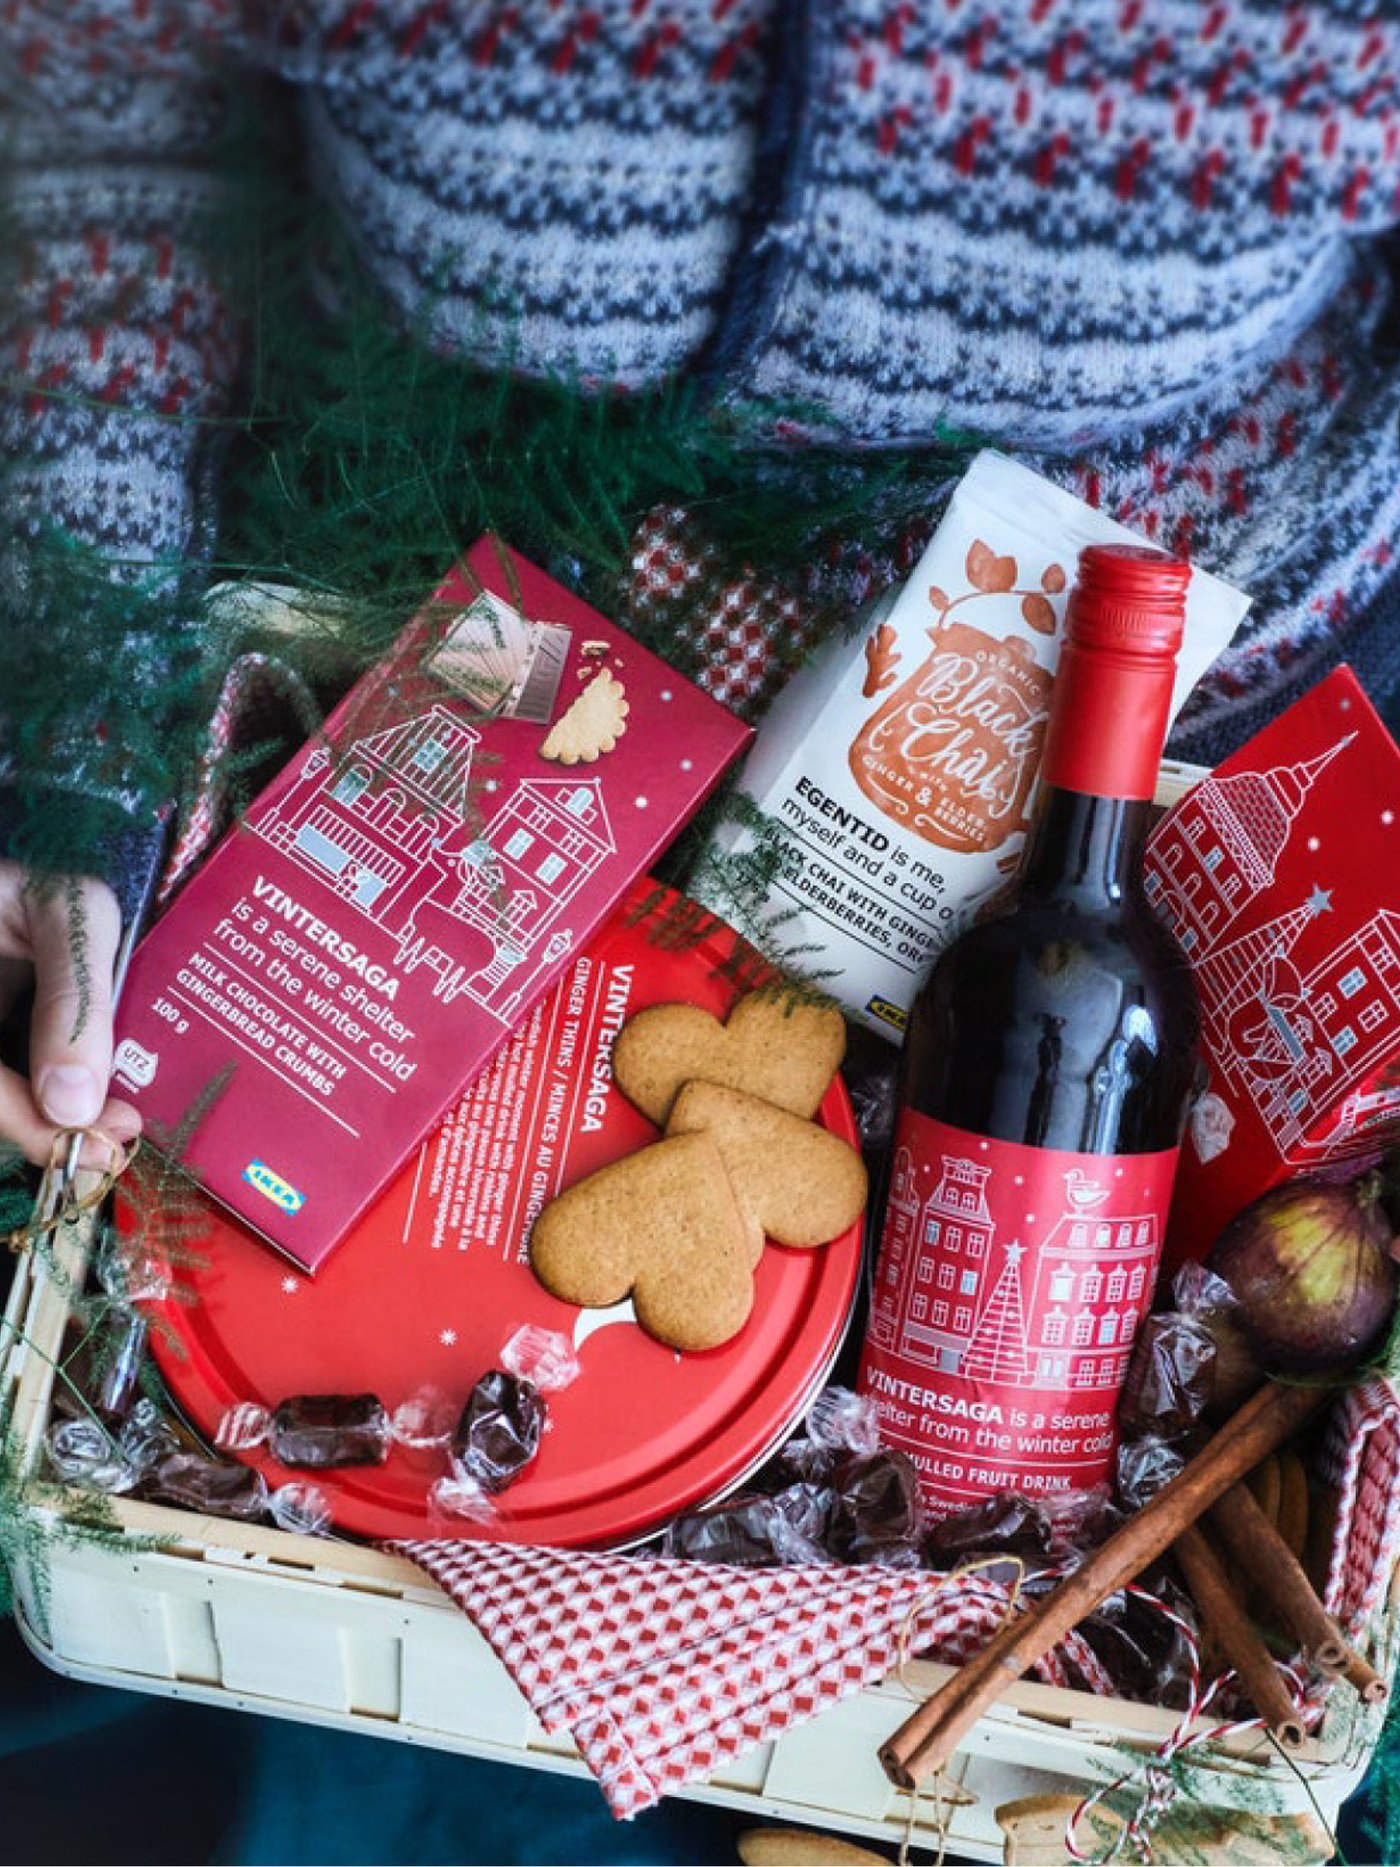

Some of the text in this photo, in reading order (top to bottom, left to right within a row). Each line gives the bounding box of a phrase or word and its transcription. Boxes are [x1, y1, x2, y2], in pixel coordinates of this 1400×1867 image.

[916, 651, 1050, 757] Black
[900, 701, 1010, 800] Chai
[914, 786, 932, 807] &
[781, 797, 955, 922] myself and a cup o
[795, 775, 946, 894] EGENTID is me,
[807, 863, 846, 894] CHAI
[847, 887, 887, 921] WITH
[231, 896, 415, 1045] is a serene shelter
[253, 875, 400, 1001] VINTERSAGA
[151, 997, 191, 1035] 100 g
[188, 952, 347, 1081] MILK CHOCOLATE WITH
[213, 917, 418, 1083] from the winter cold
[567, 957, 593, 1015] GINGER
[176, 968, 335, 1096] GINGERBREAD CRUMBS
[557, 1019, 581, 1068] THINS
[580, 965, 635, 1133] VINTERSAGA
[540, 1083, 567, 1143] MINCES
[248, 1166, 299, 1209] IKEA
[536, 1145, 554, 1169] AU
[866, 1365, 1111, 1430] VINTERSAGA is a serene
[876, 1400, 1115, 1454] elter from the winter cold
[967, 1465, 1020, 1489] FRUIT
[1020, 1474, 1073, 1491] DRINK
